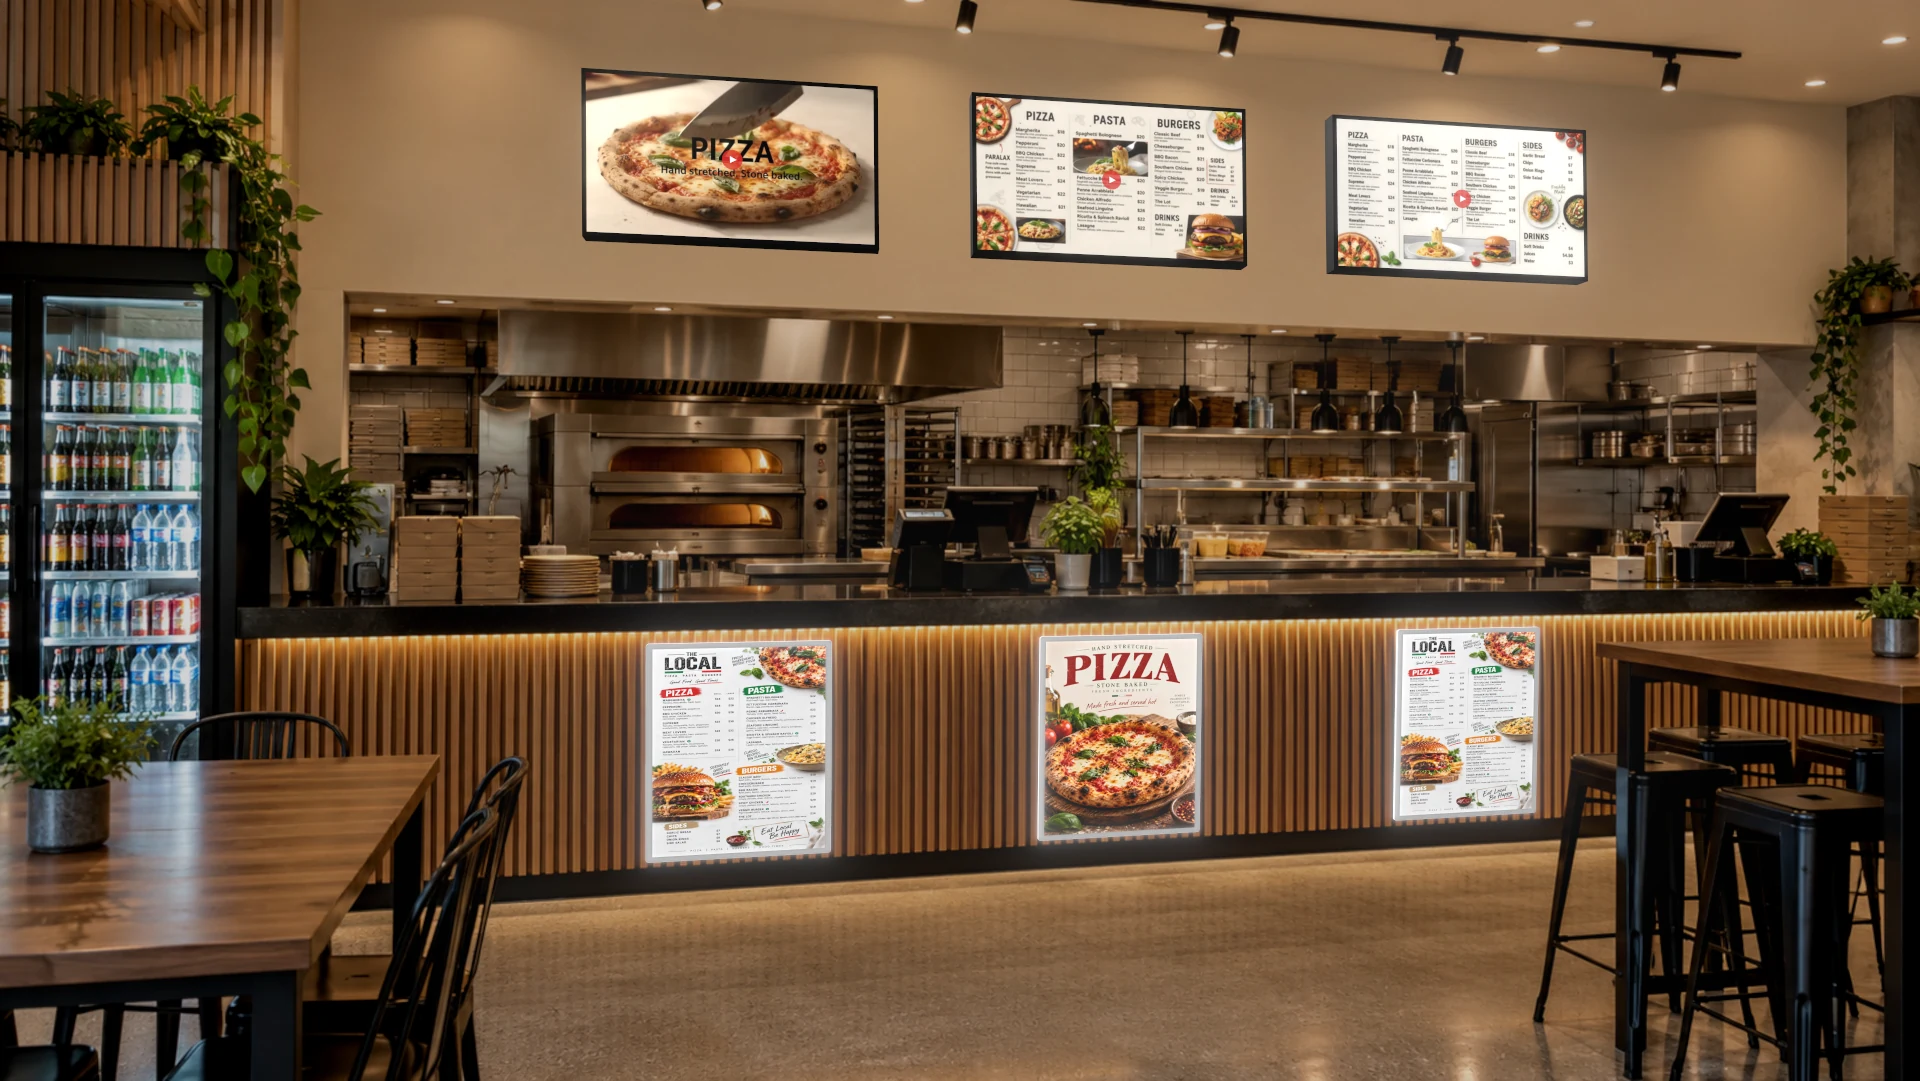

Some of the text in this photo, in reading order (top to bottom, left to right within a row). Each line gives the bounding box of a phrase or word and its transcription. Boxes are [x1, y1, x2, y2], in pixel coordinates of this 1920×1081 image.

[1026, 111, 1055, 122] PIZZA
[1094, 115, 1126, 126] PASTA
[1157, 119, 1200, 130] BURGERS
[1348, 131, 1369, 139] PIZZA
[1402, 135, 1424, 143] PASTA
[1465, 139, 1497, 147] BURGERS
[1523, 142, 1542, 150] SIDES
[691, 137, 774, 163] PIZZA
[661, 166, 686, 175] Hand
[742, 170, 768, 179] Stone
[772, 171, 802, 181] baked.
[1155, 214, 1179, 222] DRINKS
[1524, 233, 1549, 241] DRINKS
[1412, 641, 1455, 653] LOCAL
[665, 656, 721, 671] LOCAL
[1064, 653, 1180, 687] PIZZA
[666, 689, 694, 697] PIZZA
[747, 686, 776, 695] PASTA
[1086, 702, 1102, 710] Made
[1469, 736, 1496, 744] BURGERS
[741, 765, 777, 775] BURGERS
[1493, 786, 1507, 794] Local
[668, 822, 688, 830] SIDES
[761, 822, 792, 835] Eat Local
[770, 828, 800, 839] Be Happy
